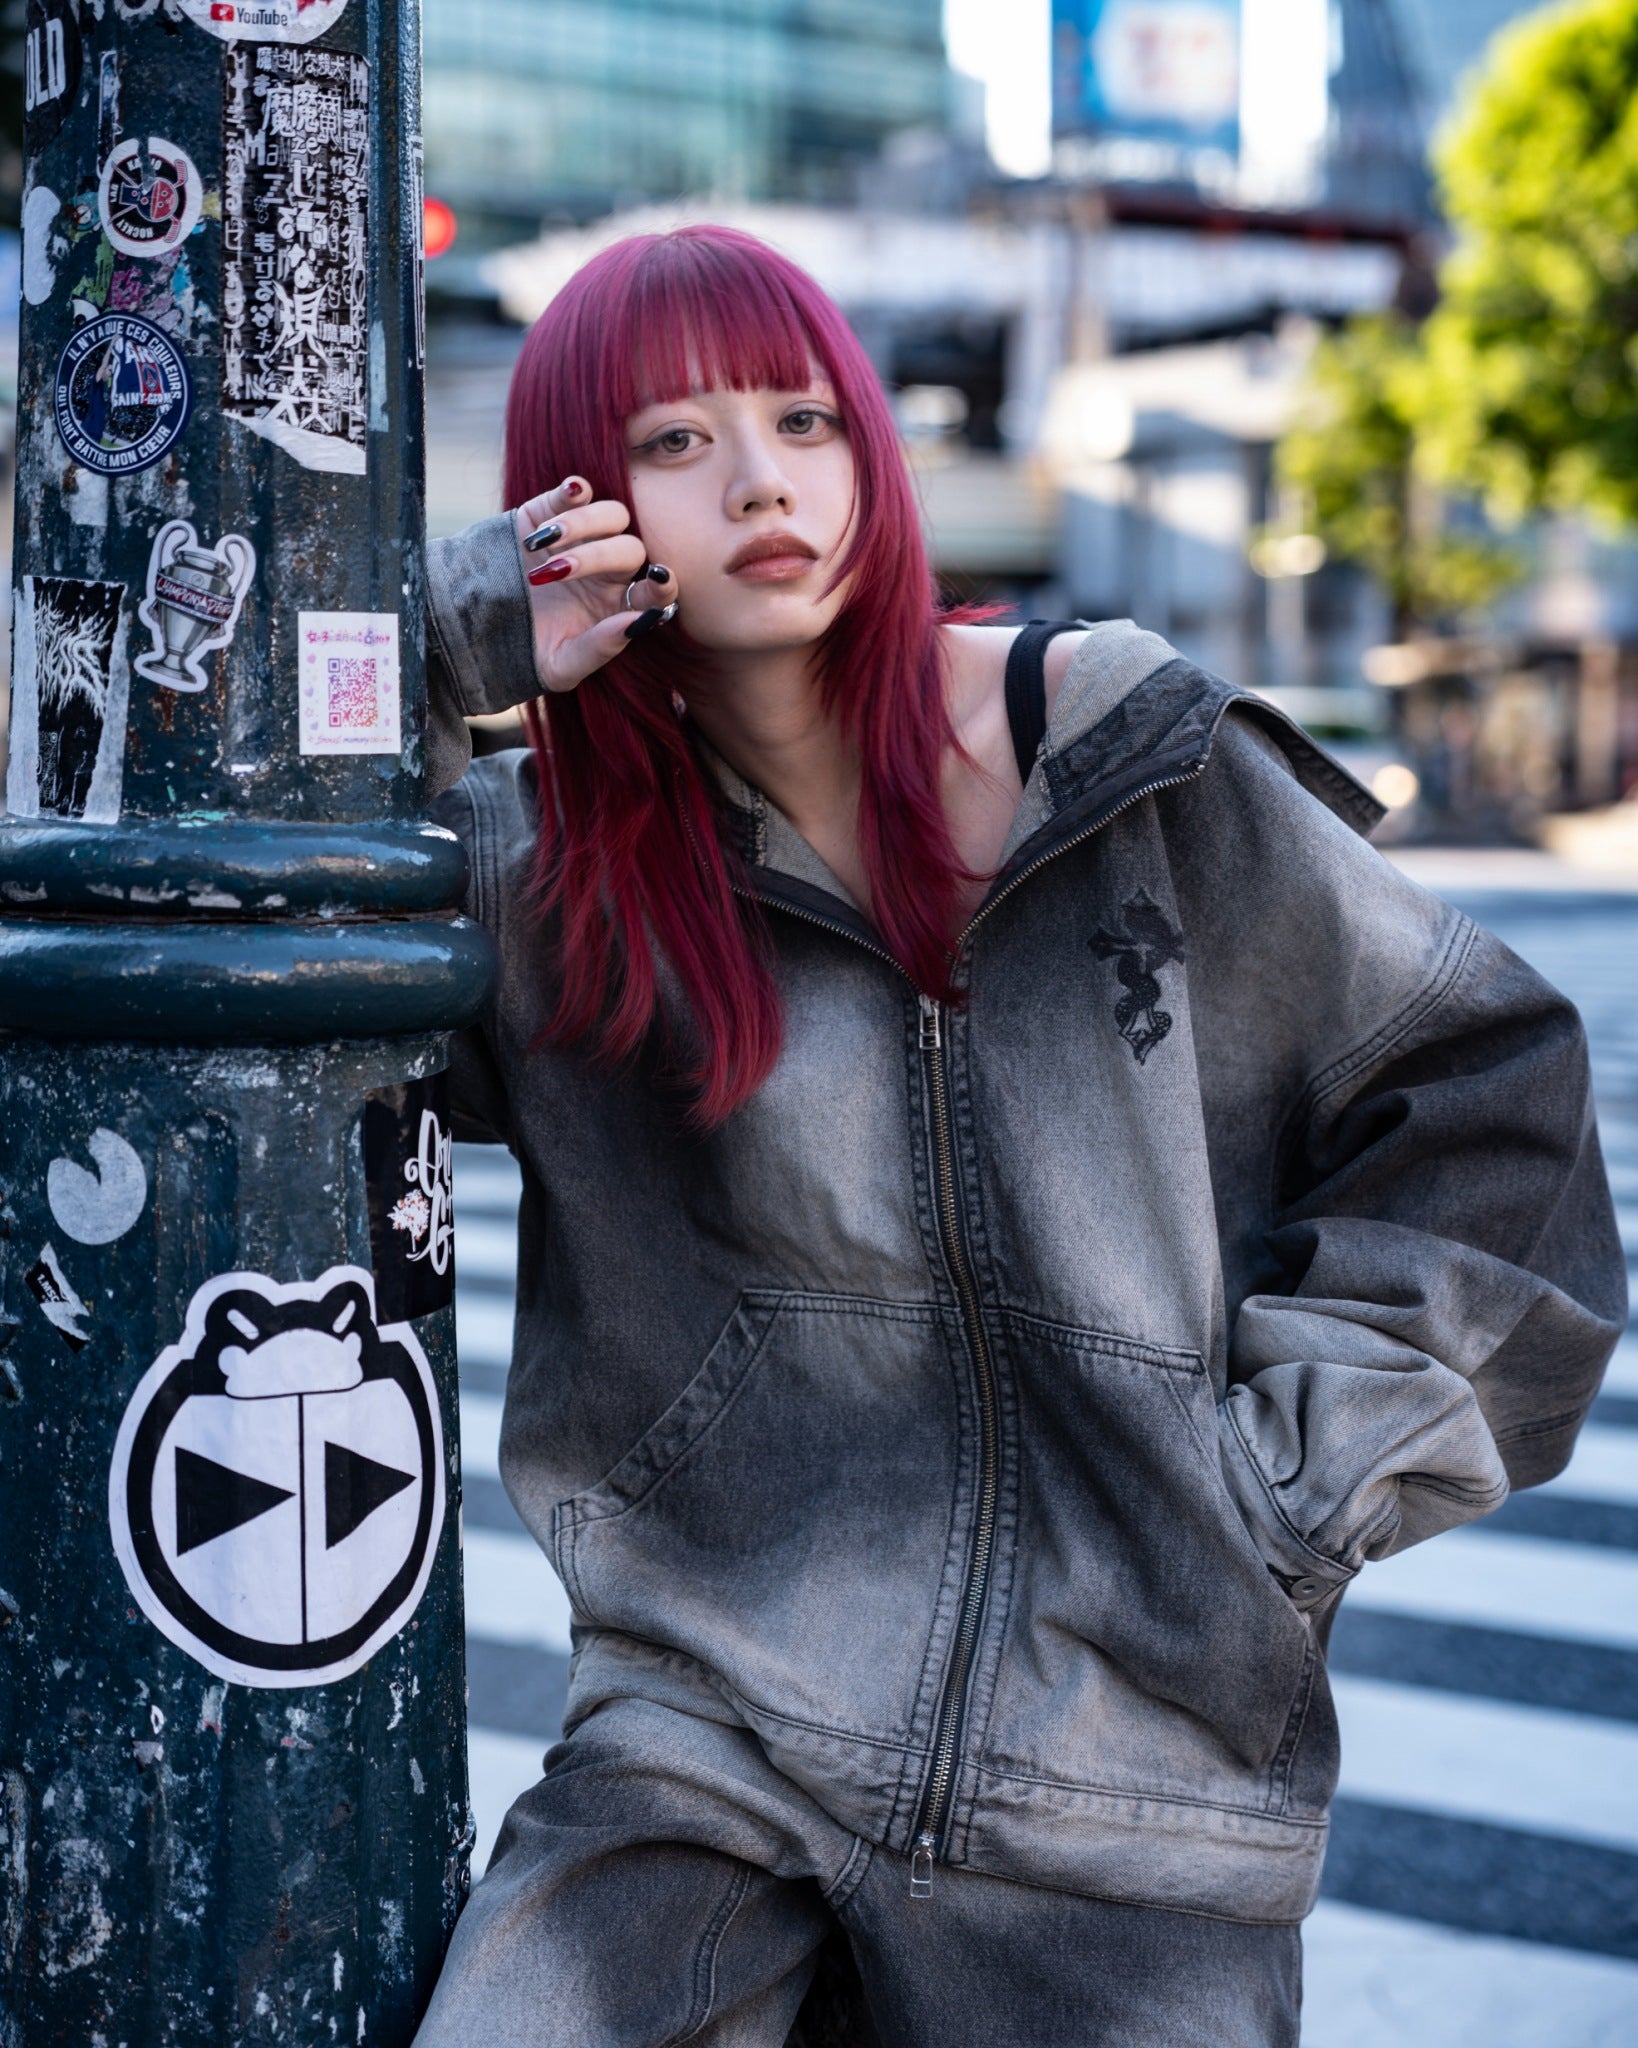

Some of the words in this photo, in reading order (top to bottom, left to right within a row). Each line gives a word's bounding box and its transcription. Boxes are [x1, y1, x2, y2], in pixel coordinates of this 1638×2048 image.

[237, 7, 288, 26] YouTube
[116, 219, 154, 239] HOCKEY
[125, 323, 150, 343] CES
[147, 337, 182, 400] COULEURS
[58, 385, 67, 408] QUI
[59, 410, 79, 441] FONT
[73, 438, 109, 467] BATTRE
[109, 451, 138, 467] MON
